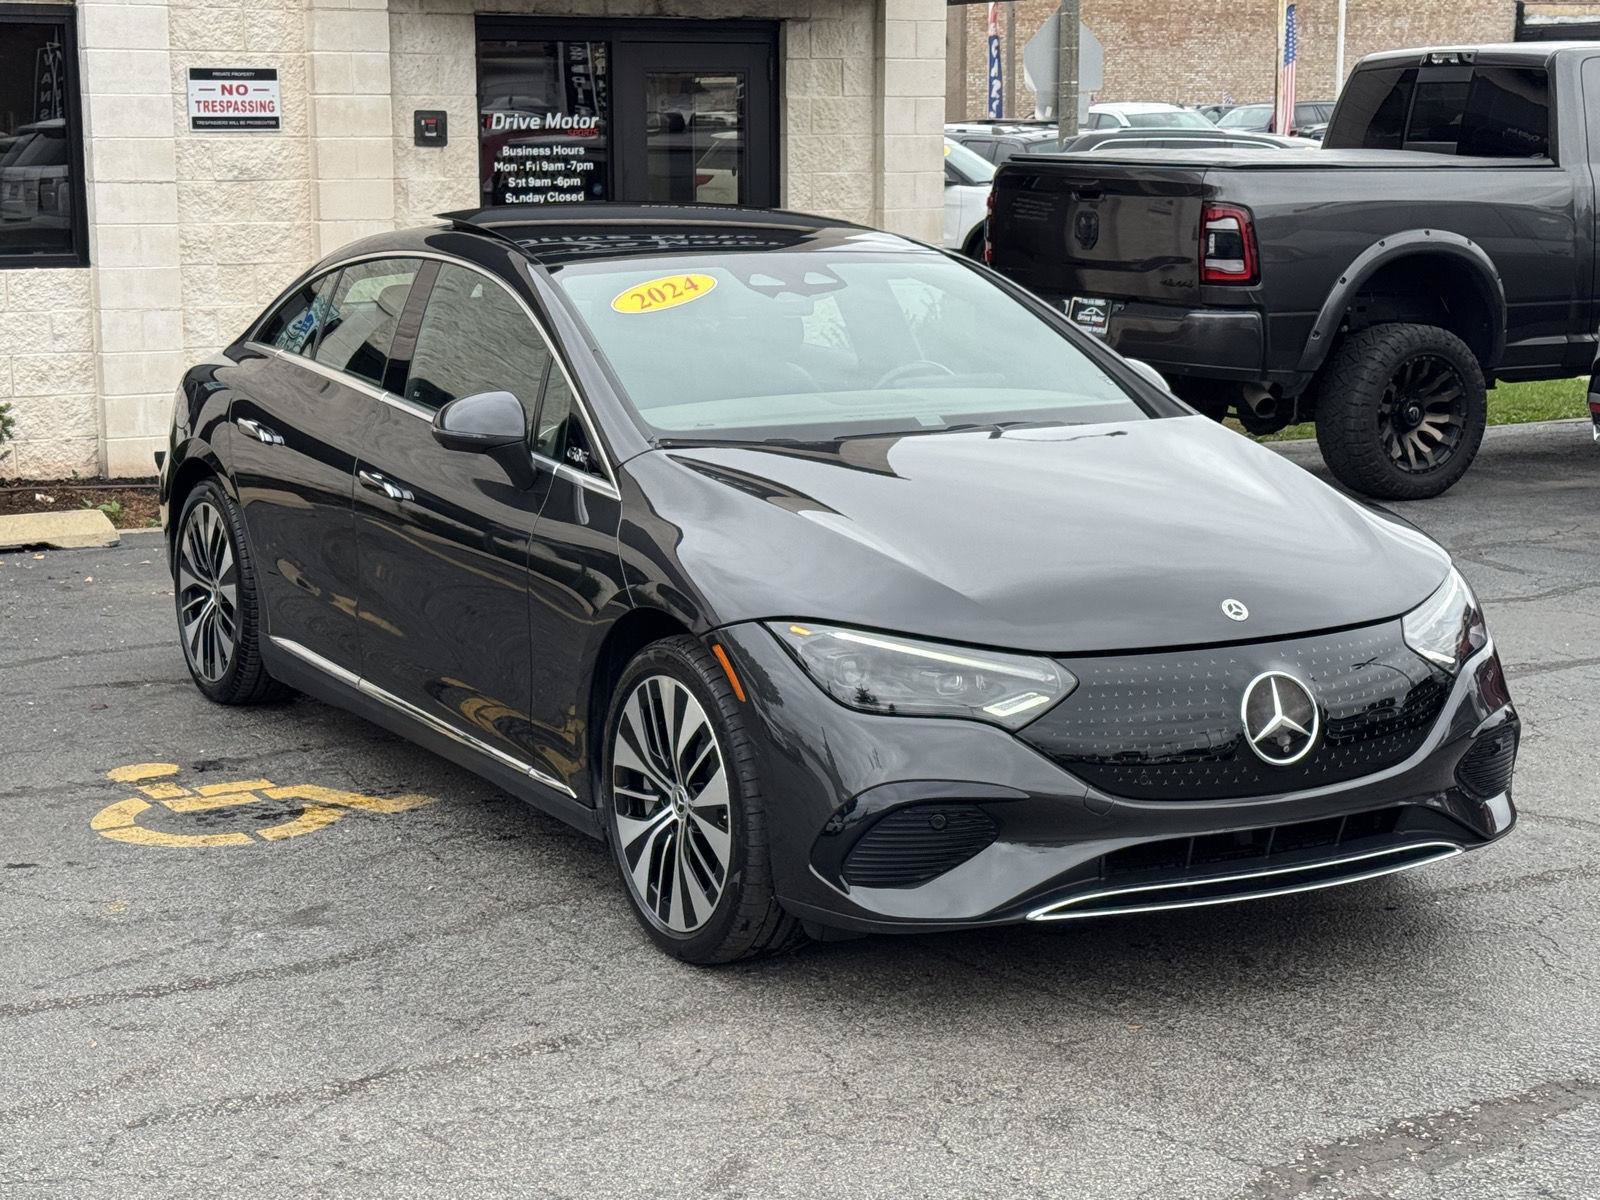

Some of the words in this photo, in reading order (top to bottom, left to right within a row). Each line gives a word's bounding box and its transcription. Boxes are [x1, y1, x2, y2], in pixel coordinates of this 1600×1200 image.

[221, 84, 248, 96] NO
[195, 100, 275, 113] TRESPASSING
[545, 112, 599, 130] Motor
[502, 146, 551, 156] Business
[553, 145, 585, 155] Hours
[494, 162, 517, 172] Mon
[541, 162, 565, 171] 9am
[528, 178, 551, 187] 9am
[547, 192, 585, 202] Closed
[631, 277, 698, 309] 2024
